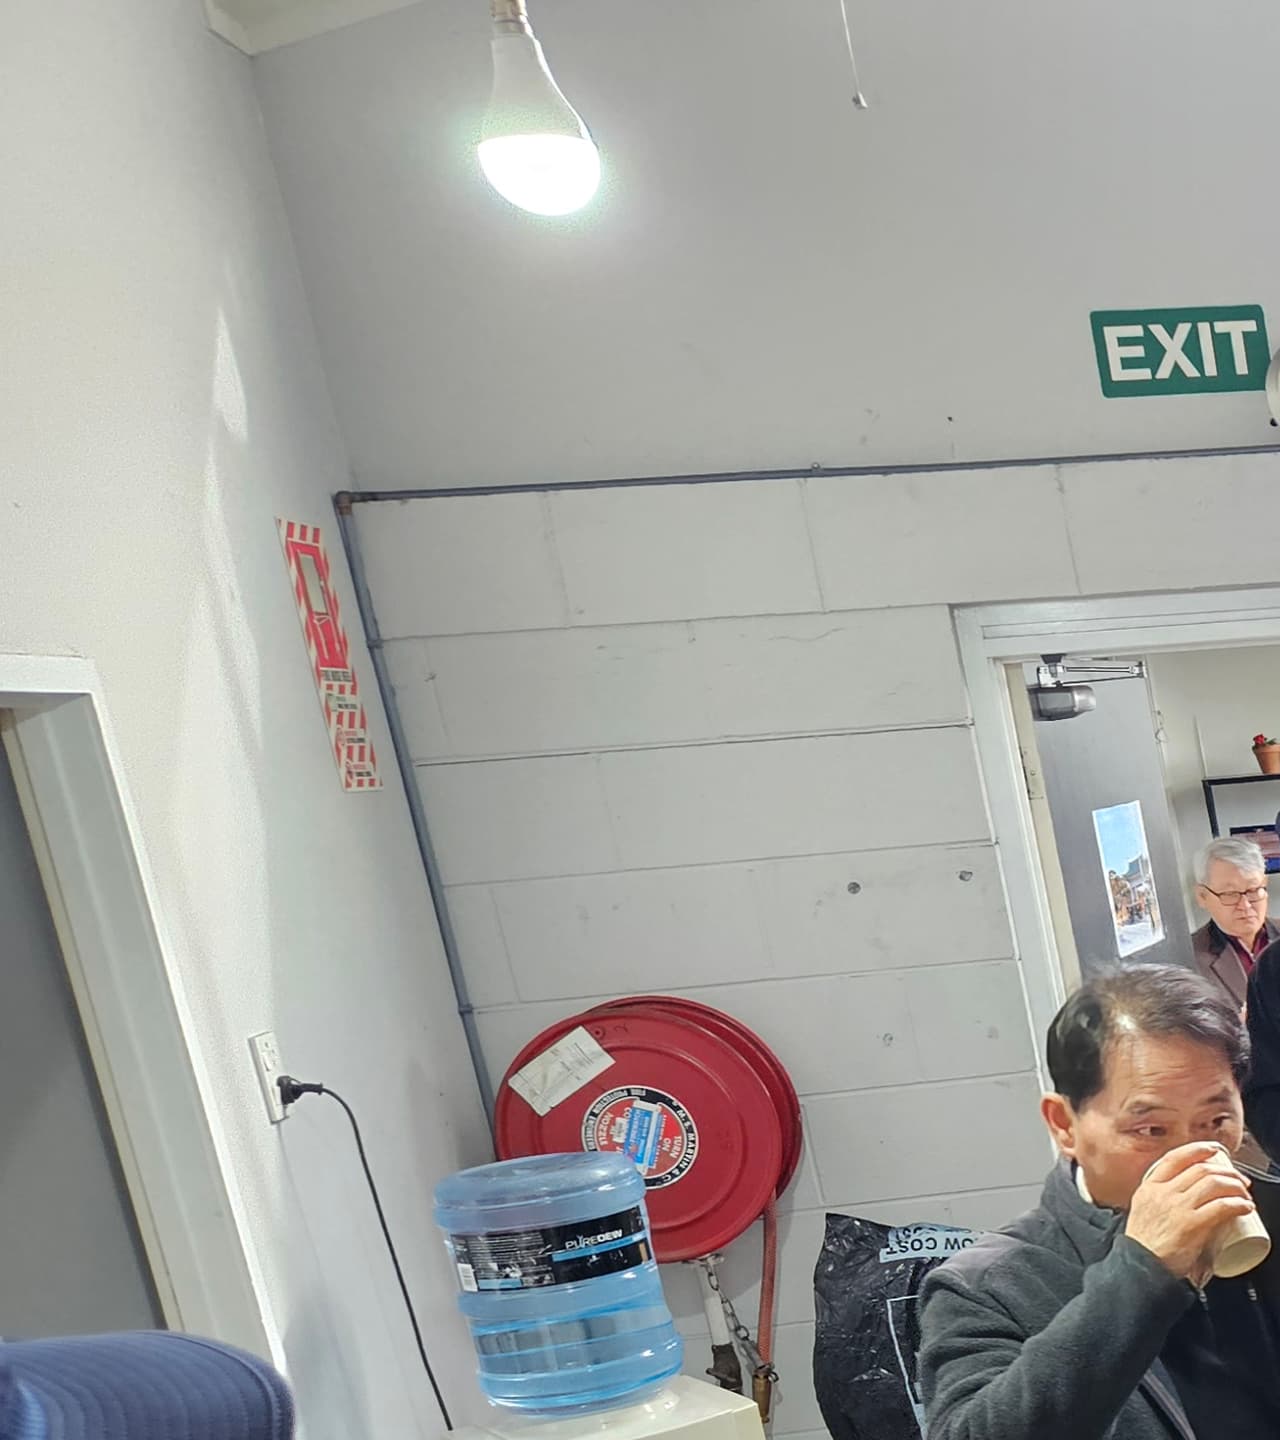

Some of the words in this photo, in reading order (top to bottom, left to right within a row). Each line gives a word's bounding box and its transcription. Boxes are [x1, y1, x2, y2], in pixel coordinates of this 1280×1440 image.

[1102, 319, 1258, 382] EXIT
[598, 1112, 614, 1146] NOZZLE
[662, 1137, 672, 1152] ON
[670, 1135, 682, 1159] TURN
[682, 1132, 696, 1169] MARTIN
[565, 1229, 623, 1251] PUREDEW
[886, 1237, 938, 1255] COST
